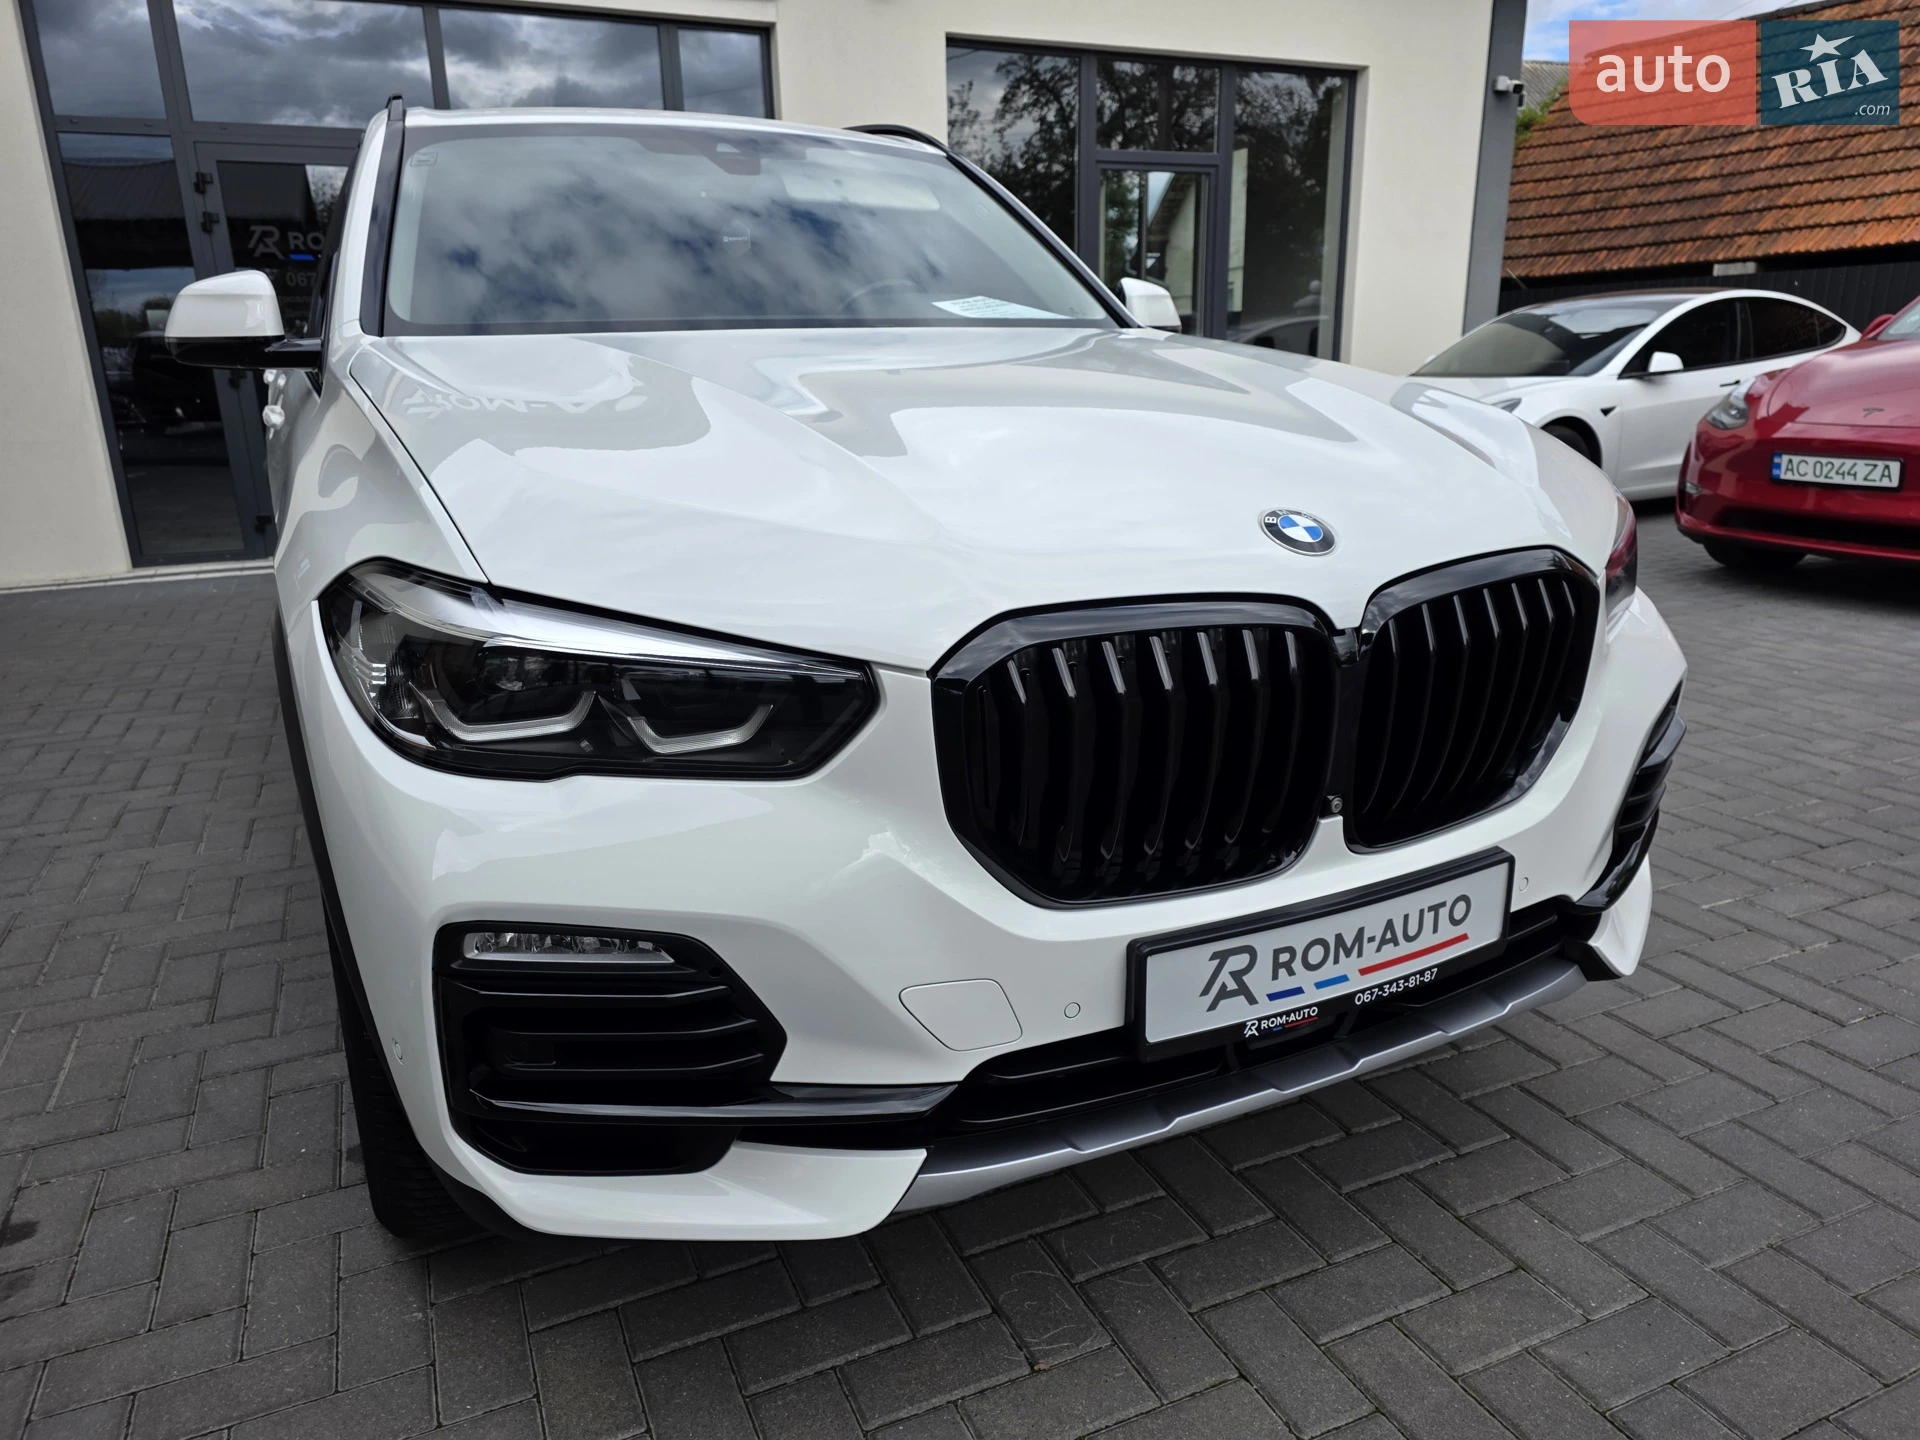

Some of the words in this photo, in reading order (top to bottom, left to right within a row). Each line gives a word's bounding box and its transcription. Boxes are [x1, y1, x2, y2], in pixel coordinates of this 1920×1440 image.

[1783, 458, 1809, 477] AC
[1813, 460, 1858, 481] 0244
[1862, 463, 1893, 483] ZA
[1270, 894, 1472, 981] ROM-AUTO
[1354, 968, 1438, 1005] 067-343-81-87
[1261, 1007, 1319, 1030] ROM-AUTO
